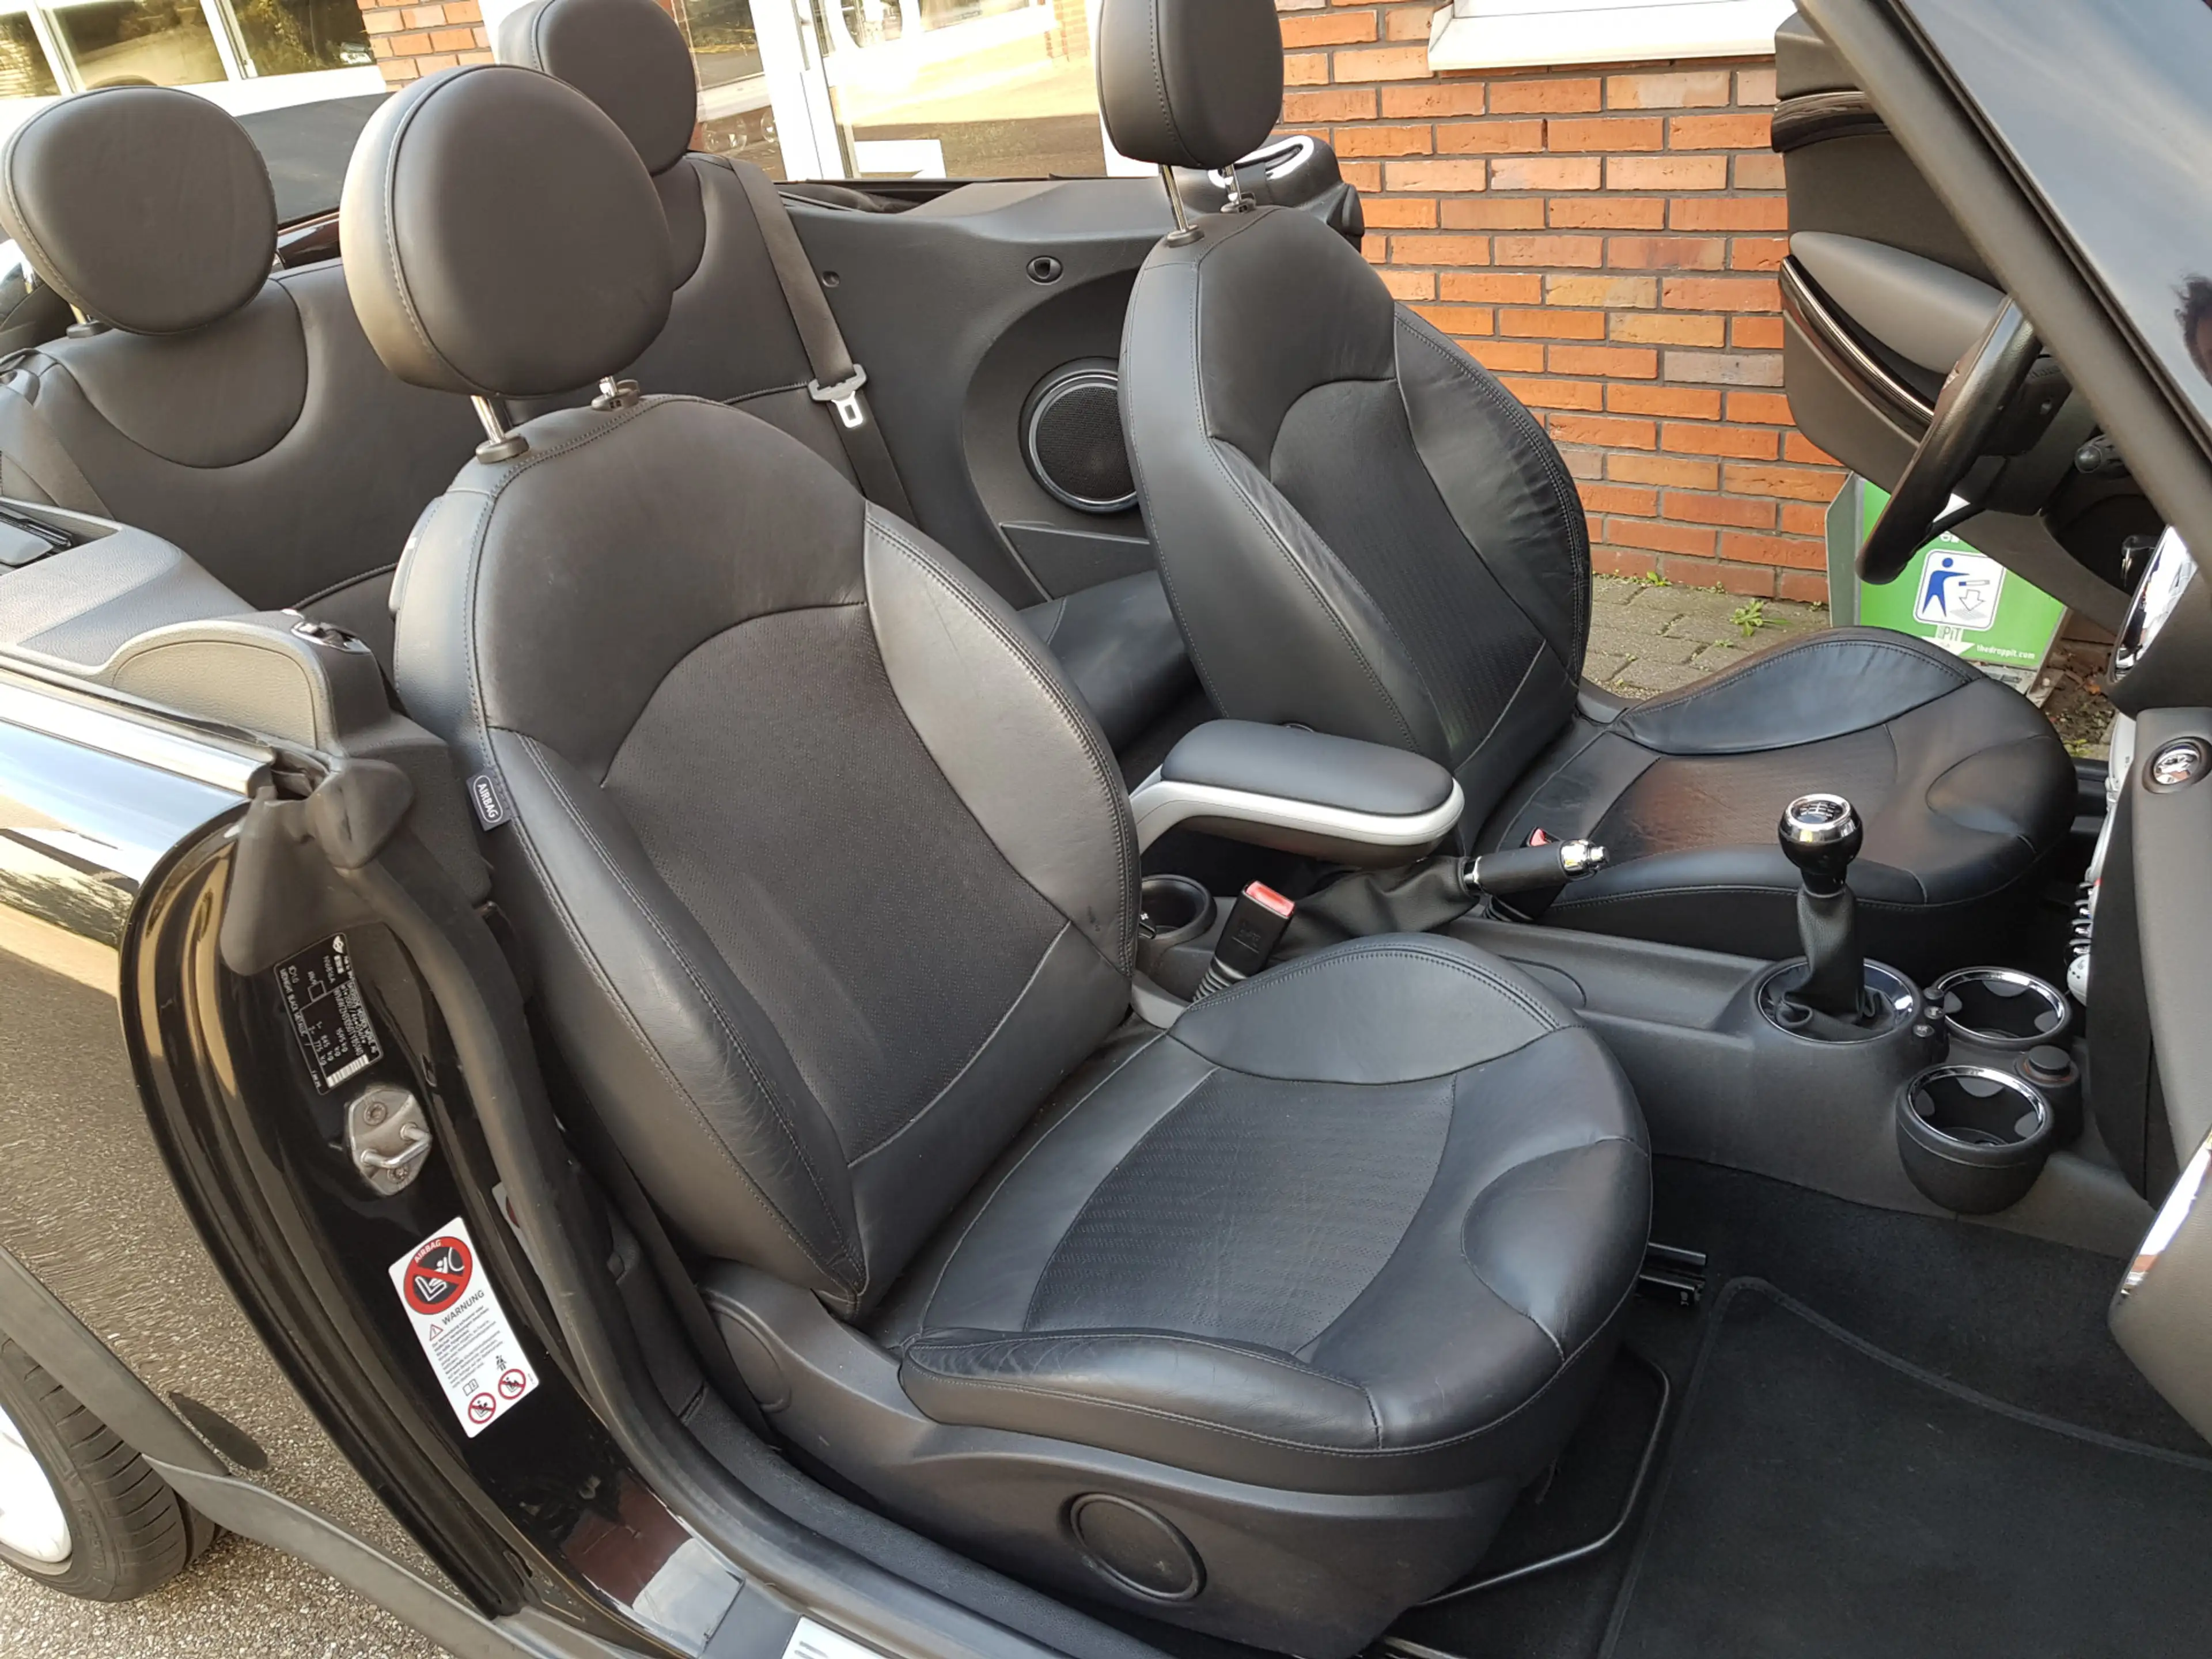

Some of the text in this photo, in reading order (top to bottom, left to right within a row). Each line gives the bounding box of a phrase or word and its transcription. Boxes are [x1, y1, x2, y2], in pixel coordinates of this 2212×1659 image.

[1976, 643, 2035, 660] thedroppit.com
[477, 783, 498, 818] AIRBAG
[414, 1238, 441, 1263] AIRBAG
[441, 1290, 484, 1324] WARNUNG
